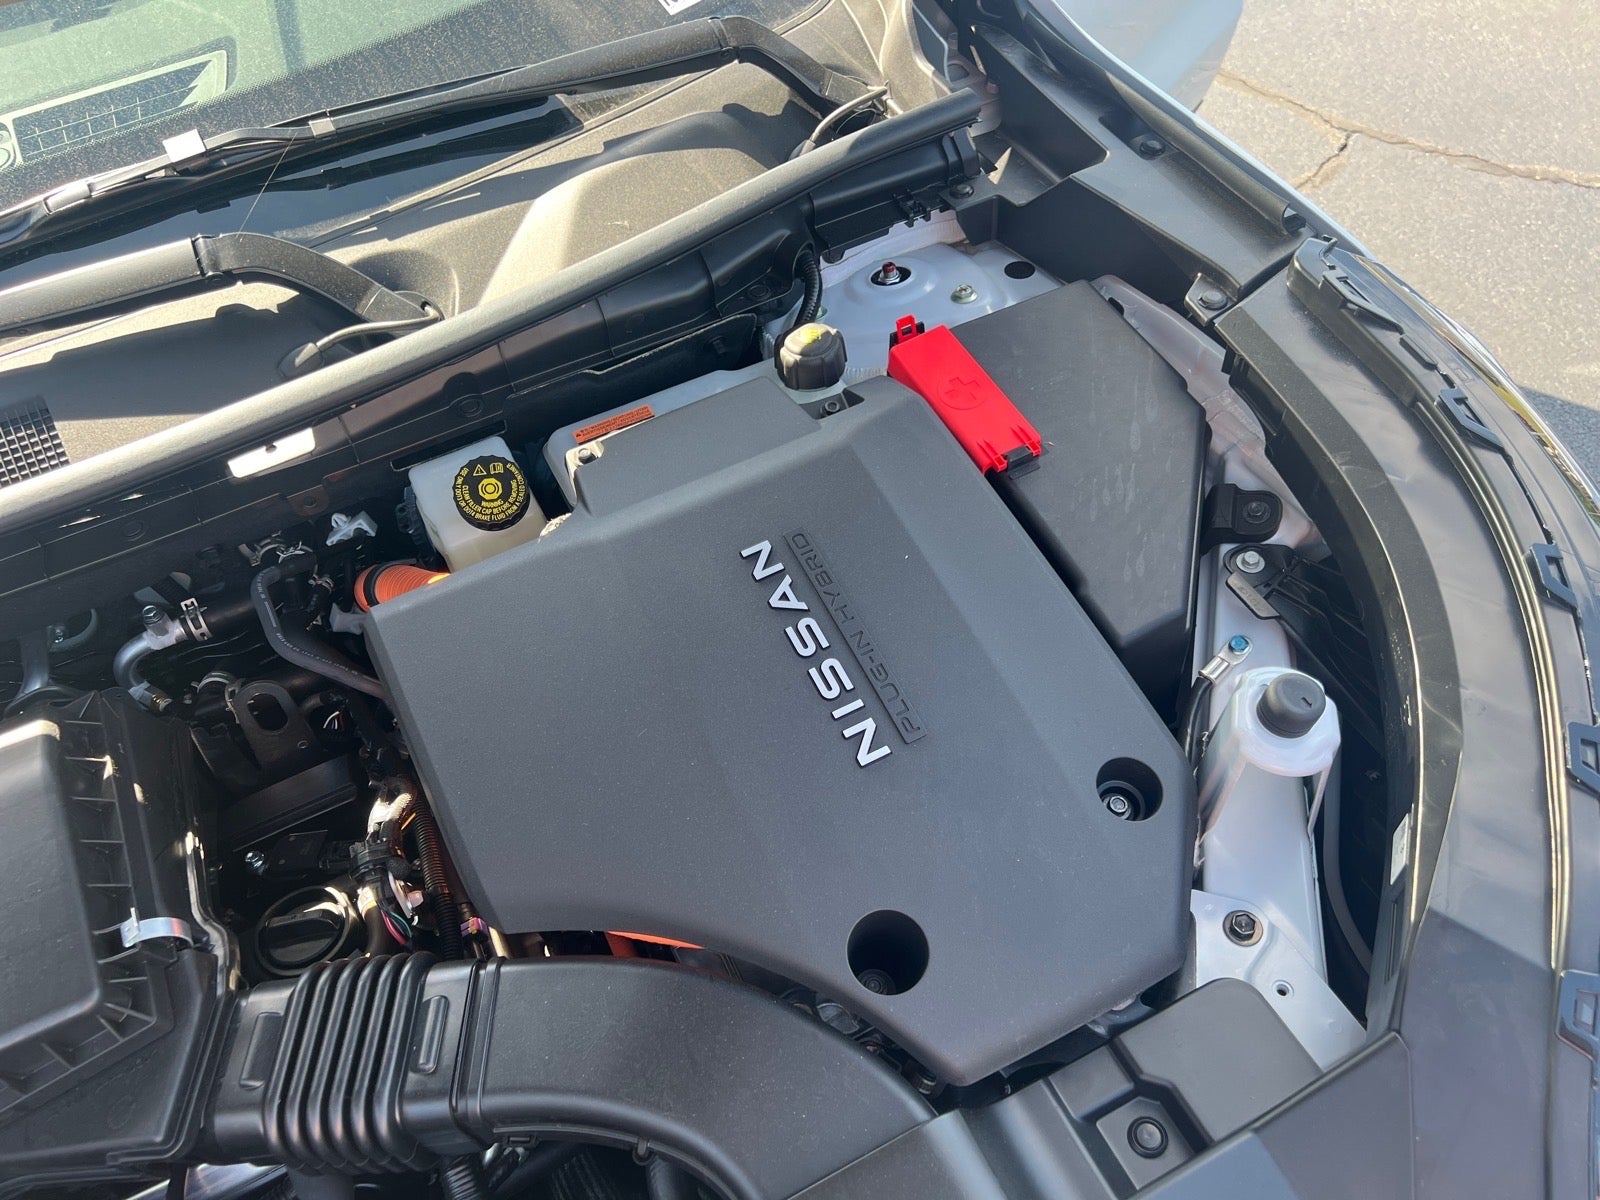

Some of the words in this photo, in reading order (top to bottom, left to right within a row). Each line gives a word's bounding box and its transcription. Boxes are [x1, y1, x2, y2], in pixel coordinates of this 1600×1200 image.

[460, 467, 469, 477] USE
[507, 463, 525, 485] CONTAINER
[462, 485, 470, 500] CLEAN
[467, 500, 482, 513] FILLER
[493, 501, 511, 514] BEFORE
[508, 480, 518, 503] REMOVING
[517, 485, 525, 502] SEALED
[463, 506, 475, 516] DOT4
[481, 499, 504, 508] WARNING
[505, 506, 518, 516] FROM
[475, 513, 490, 521] BRAKE
[791, 533, 855, 625] HYBRID
[740, 539, 892, 767] NISSAN
[849, 630, 921, 733] PLUG-IN
